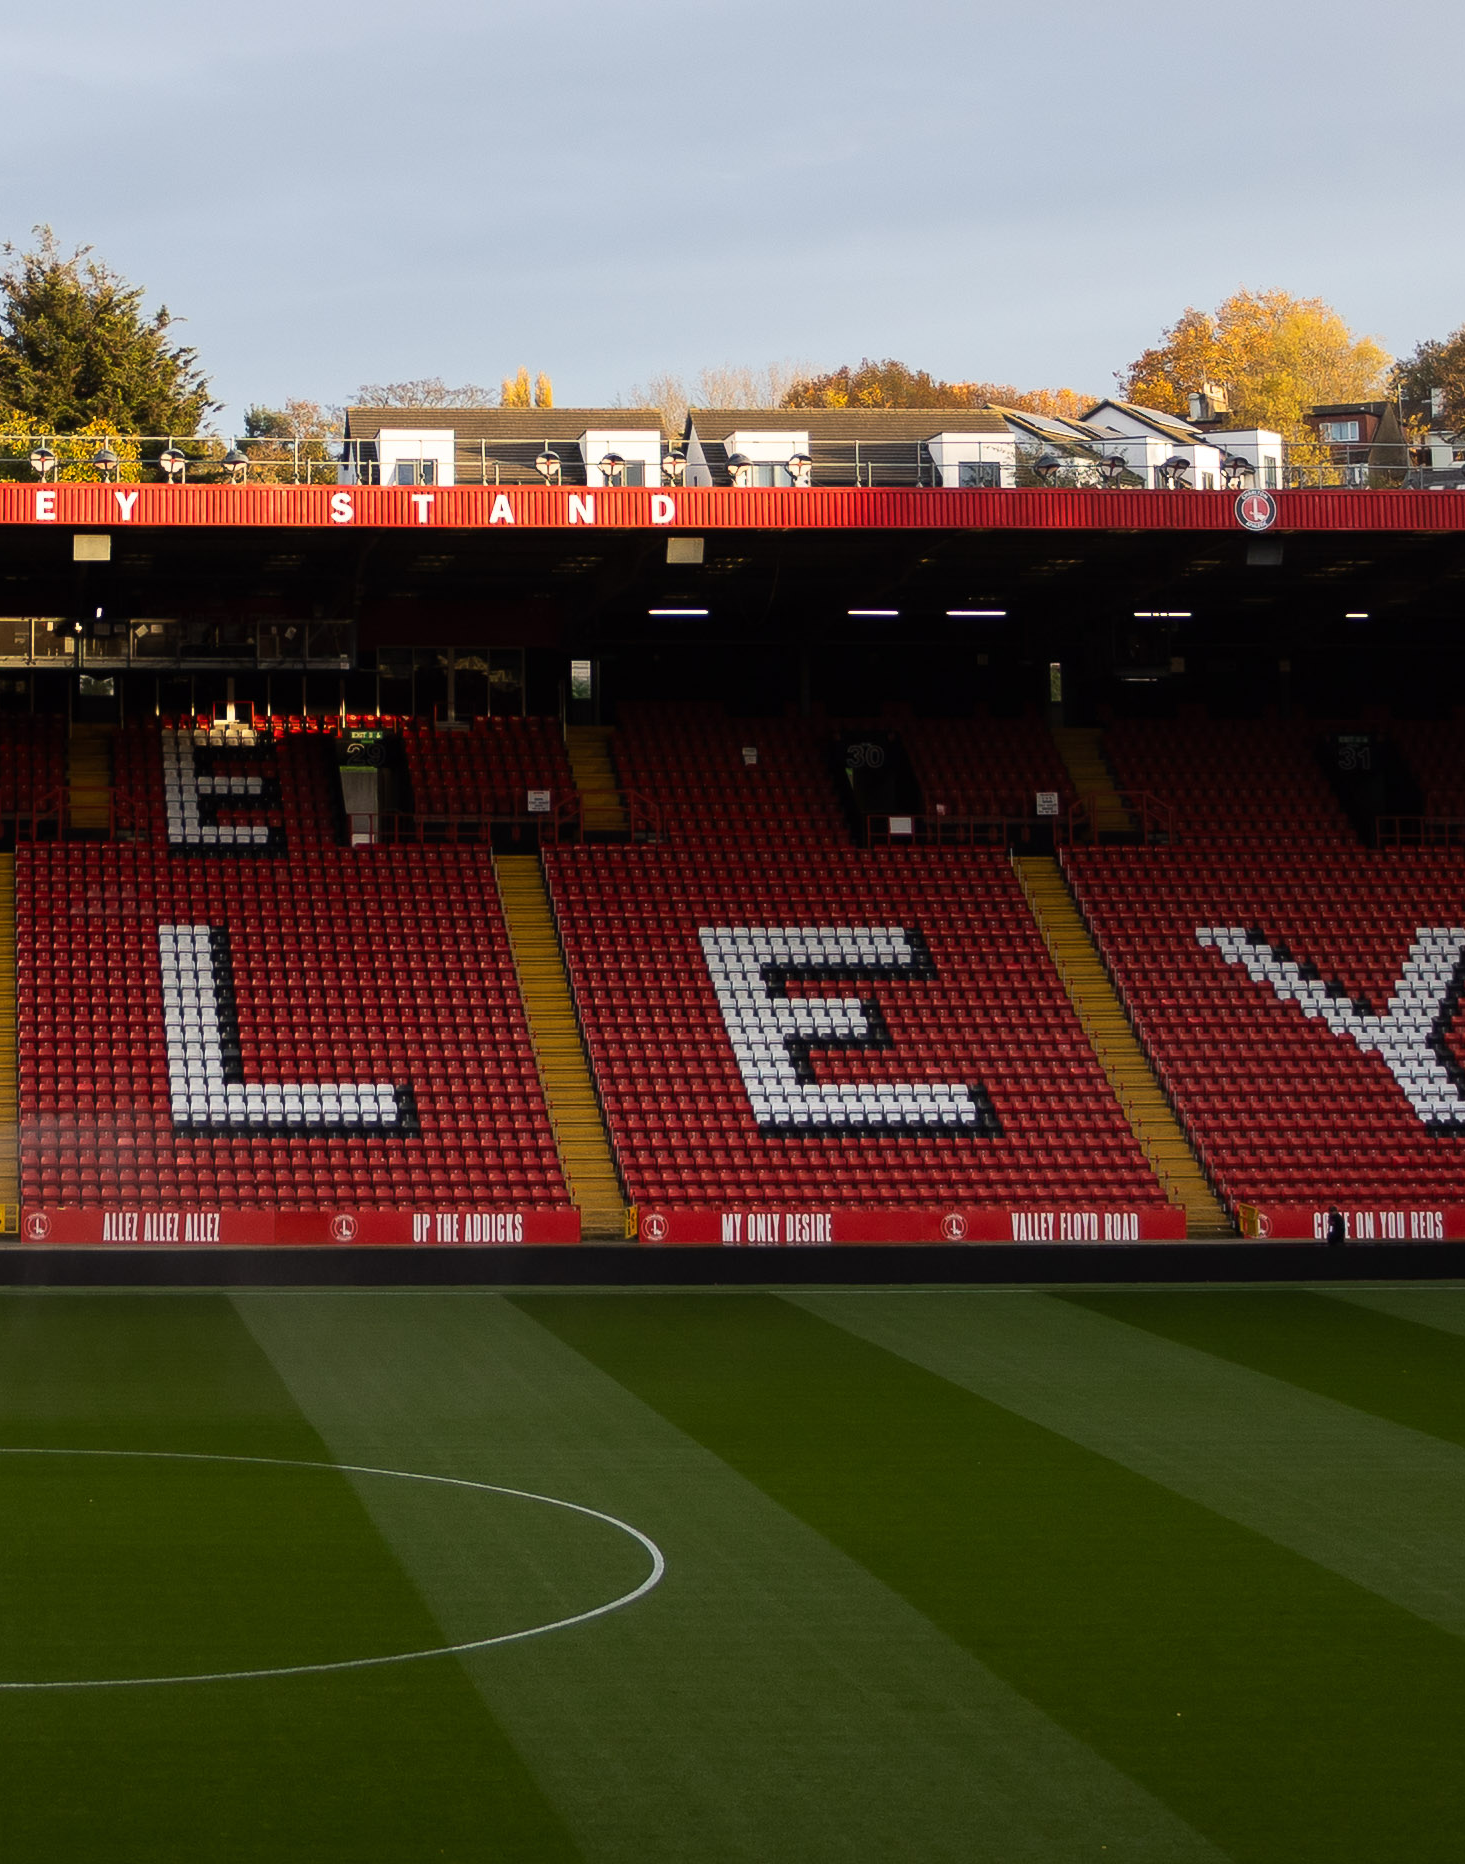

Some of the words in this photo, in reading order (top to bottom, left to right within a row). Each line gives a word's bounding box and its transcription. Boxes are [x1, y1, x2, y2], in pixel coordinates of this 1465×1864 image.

[330, 492, 676, 524] STAND
[347, 743, 386, 766] 29
[845, 744, 884, 768] 30
[1338, 746, 1372, 770] 31
[104, 1213, 137, 1241] ALLEZ
[144, 1213, 178, 1241] ALLEZ
[185, 1213, 219, 1241] ALLEZ
[414, 1214, 430, 1242] UP
[436, 1214, 458, 1242] THE
[465, 1214, 522, 1242] ADDICKS
[722, 1214, 741, 1241] MY
[748, 1214, 779, 1242] ONLY
[786, 1214, 831, 1242] DESIRE
[1012, 1213, 1053, 1241] VALLEY
[1061, 1213, 1098, 1240] FLOYD
[1105, 1213, 1138, 1240] ROAD
[1313, 1211, 1350, 1239] COE
[1356, 1212, 1374, 1238] ON
[1380, 1212, 1404, 1238] YOU
[1411, 1212, 1443, 1238] REDS
